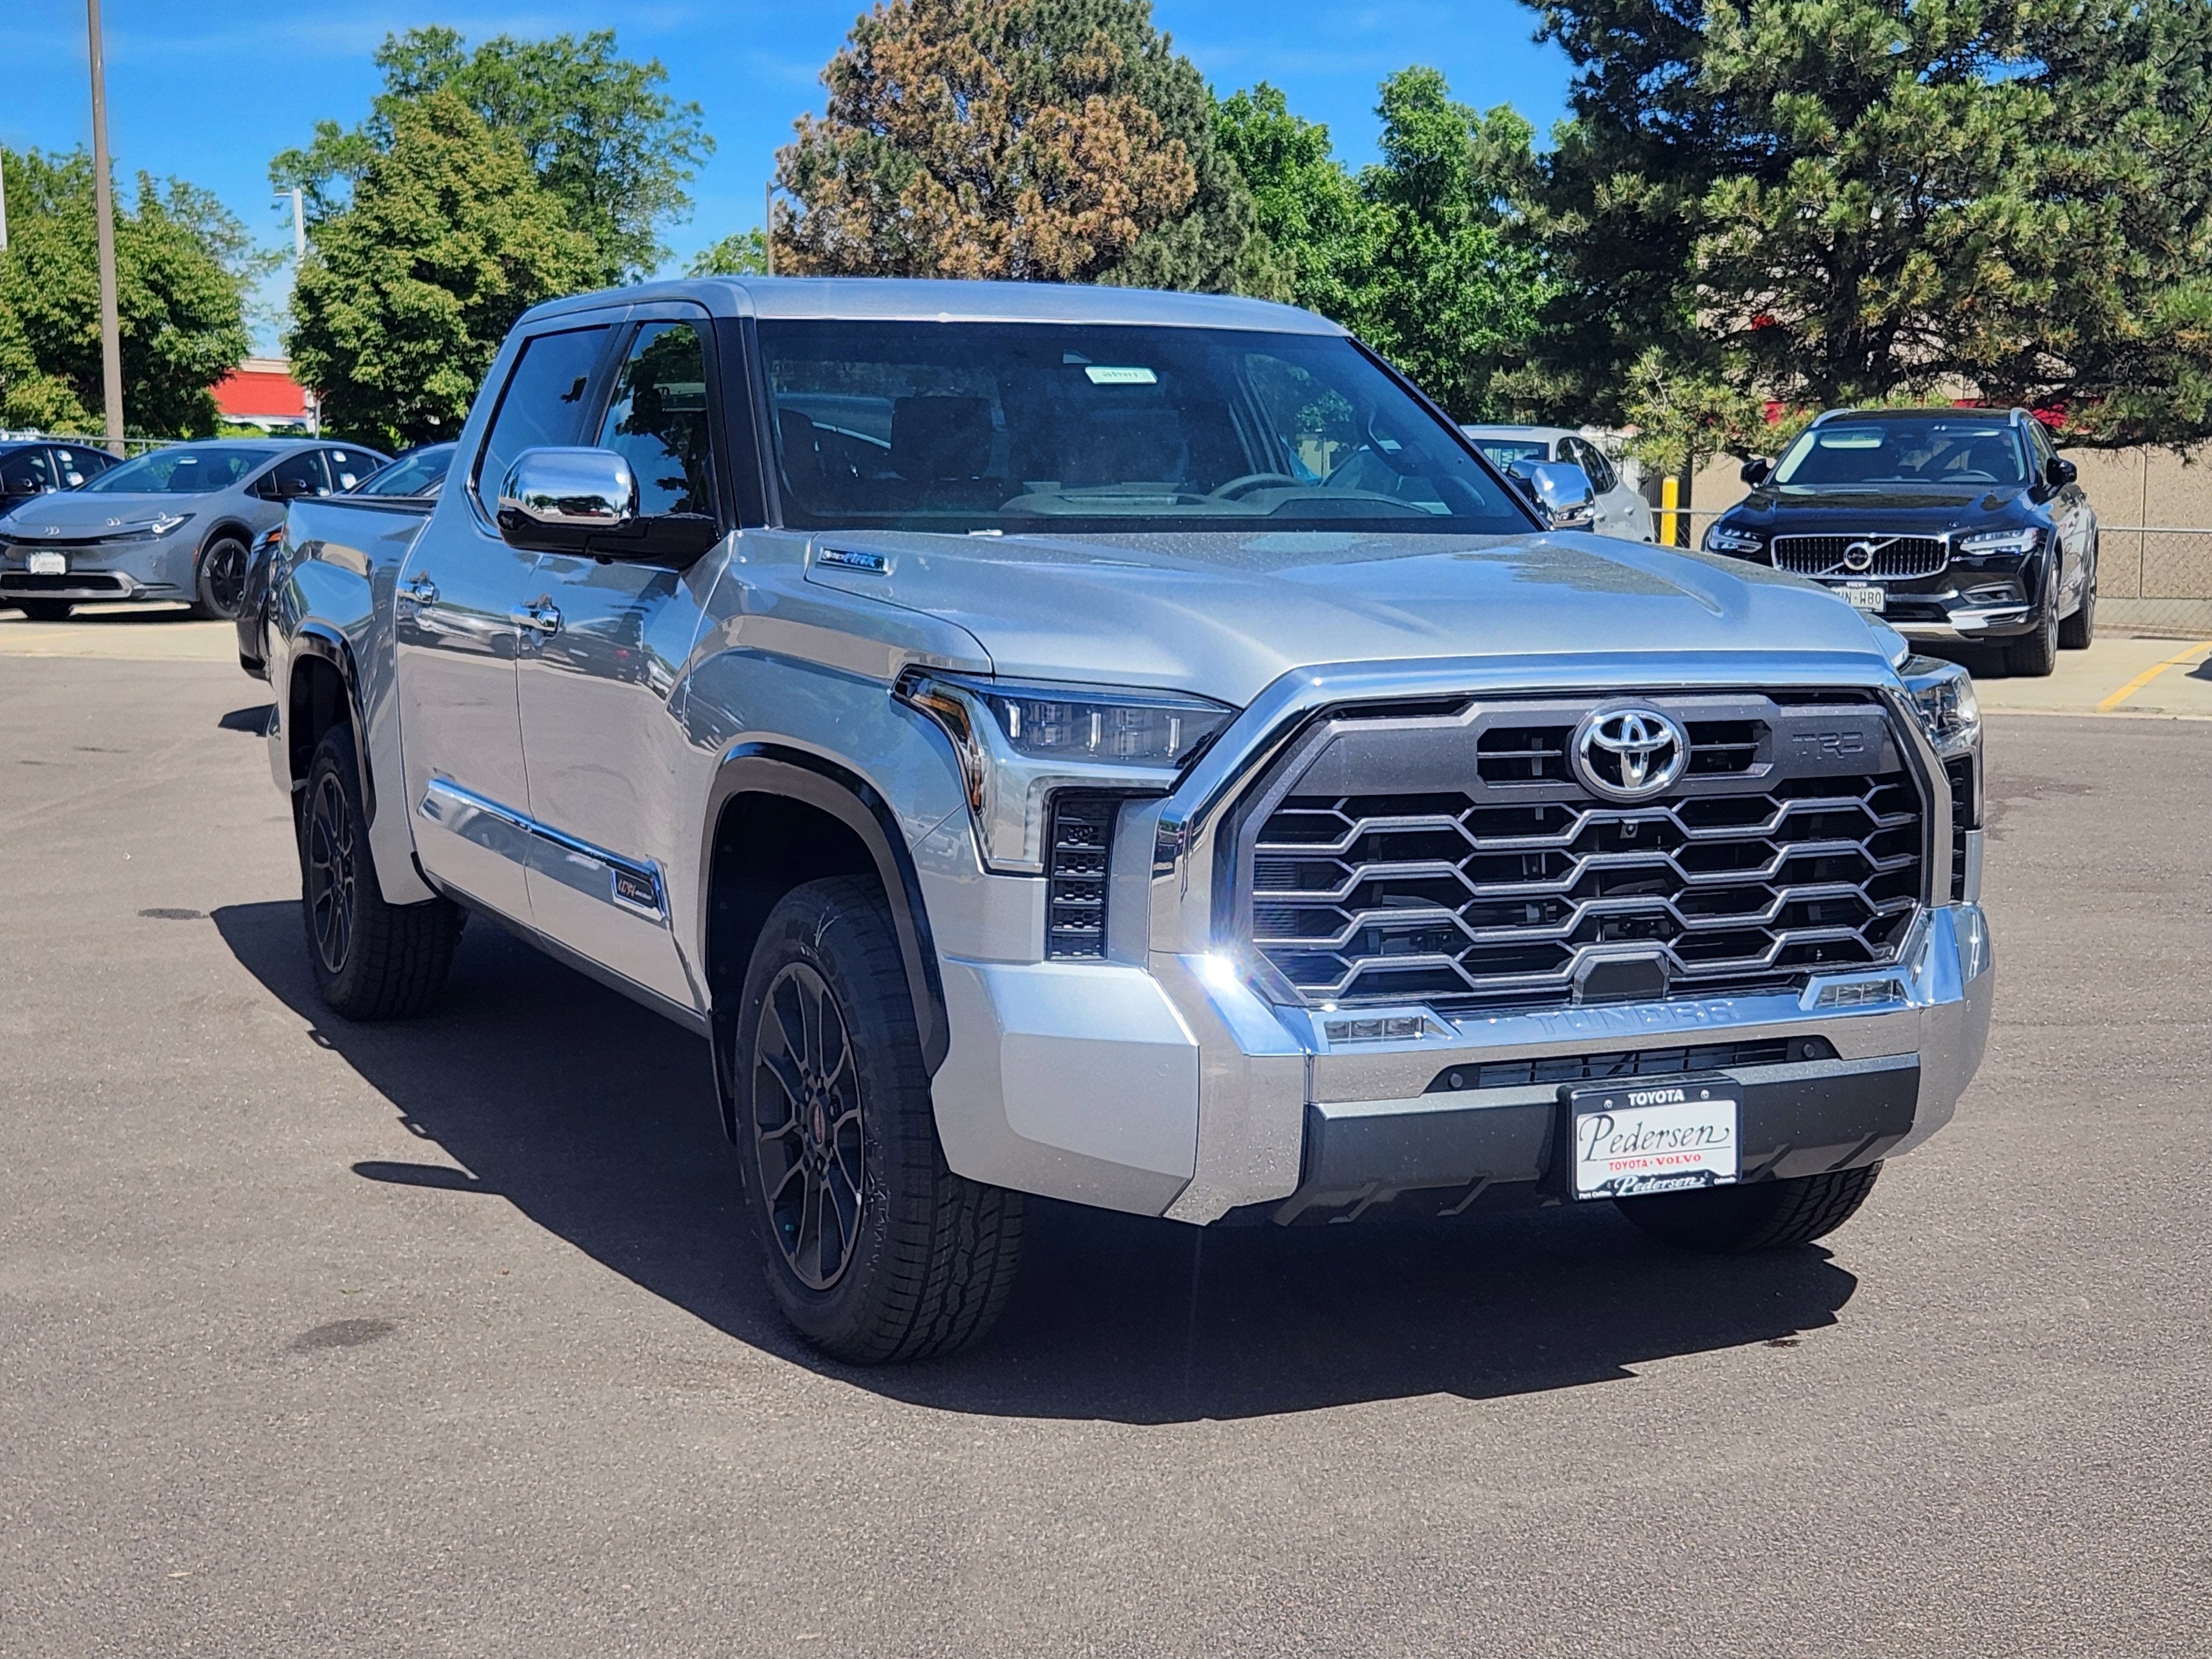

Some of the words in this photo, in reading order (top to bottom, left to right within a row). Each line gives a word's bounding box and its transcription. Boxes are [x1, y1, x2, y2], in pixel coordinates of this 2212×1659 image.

[1792, 732, 1864, 760] TRD
[1526, 1000, 1740, 1035] TUNDRA
[1627, 1089, 1685, 1105] TOYOTA
[1579, 1114, 1730, 1162] Pedersen
[1609, 1161, 1648, 1171] TOYOTA
[1656, 1154, 1702, 1166] VOLVO
[1614, 1175, 1707, 1197] Pedersen
